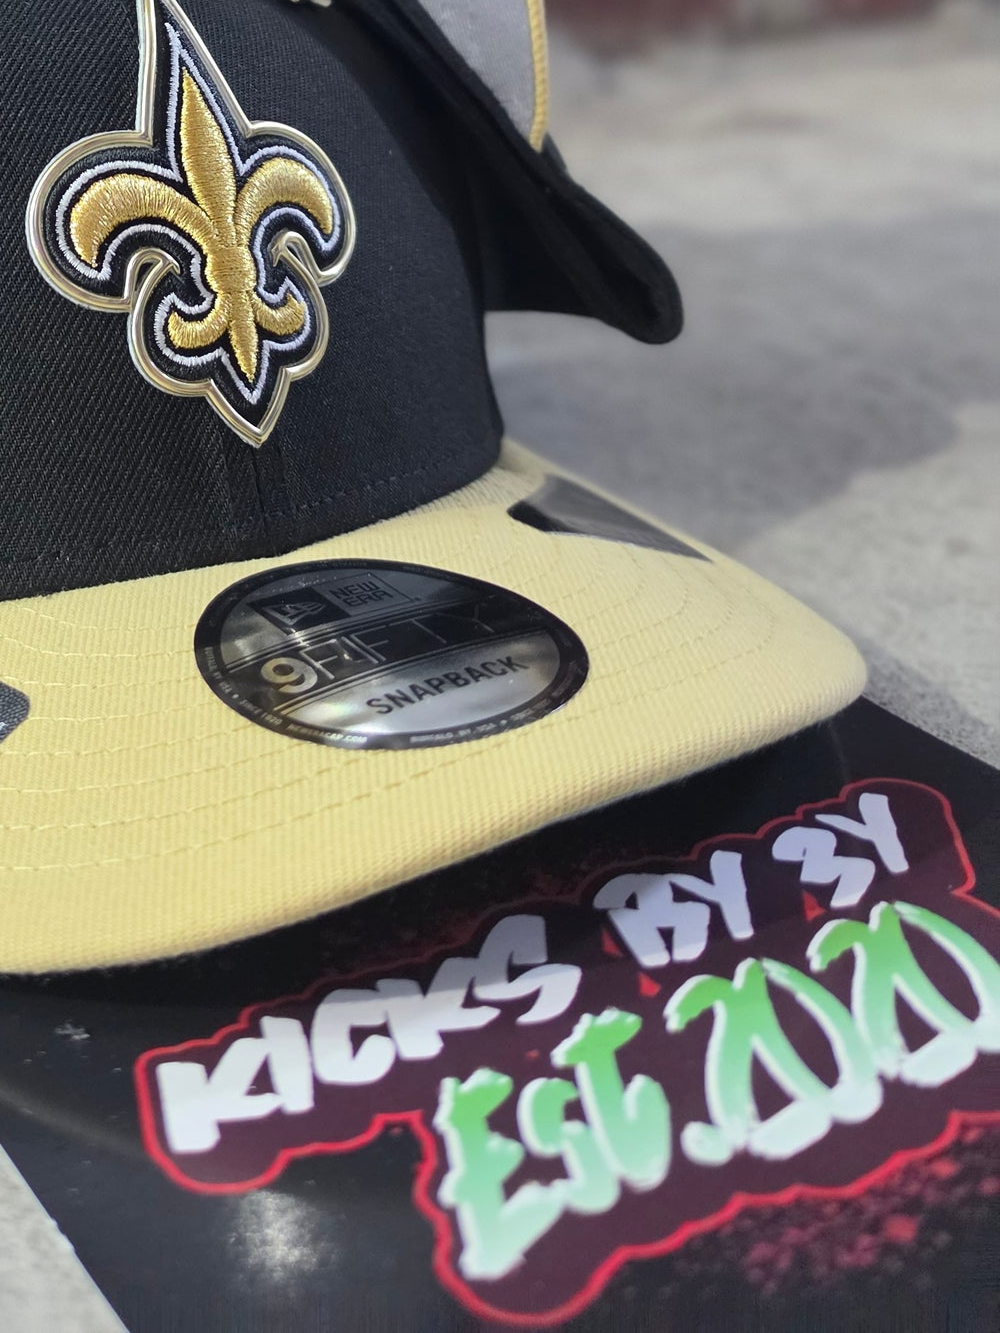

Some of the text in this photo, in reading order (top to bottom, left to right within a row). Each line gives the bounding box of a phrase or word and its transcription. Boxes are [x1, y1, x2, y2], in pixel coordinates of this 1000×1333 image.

[329, 581, 381, 599] NEW
[343, 590, 394, 608] ERA
[366, 654, 530, 716] SNAPBACK
[157, 915, 581, 1153] KICKS
